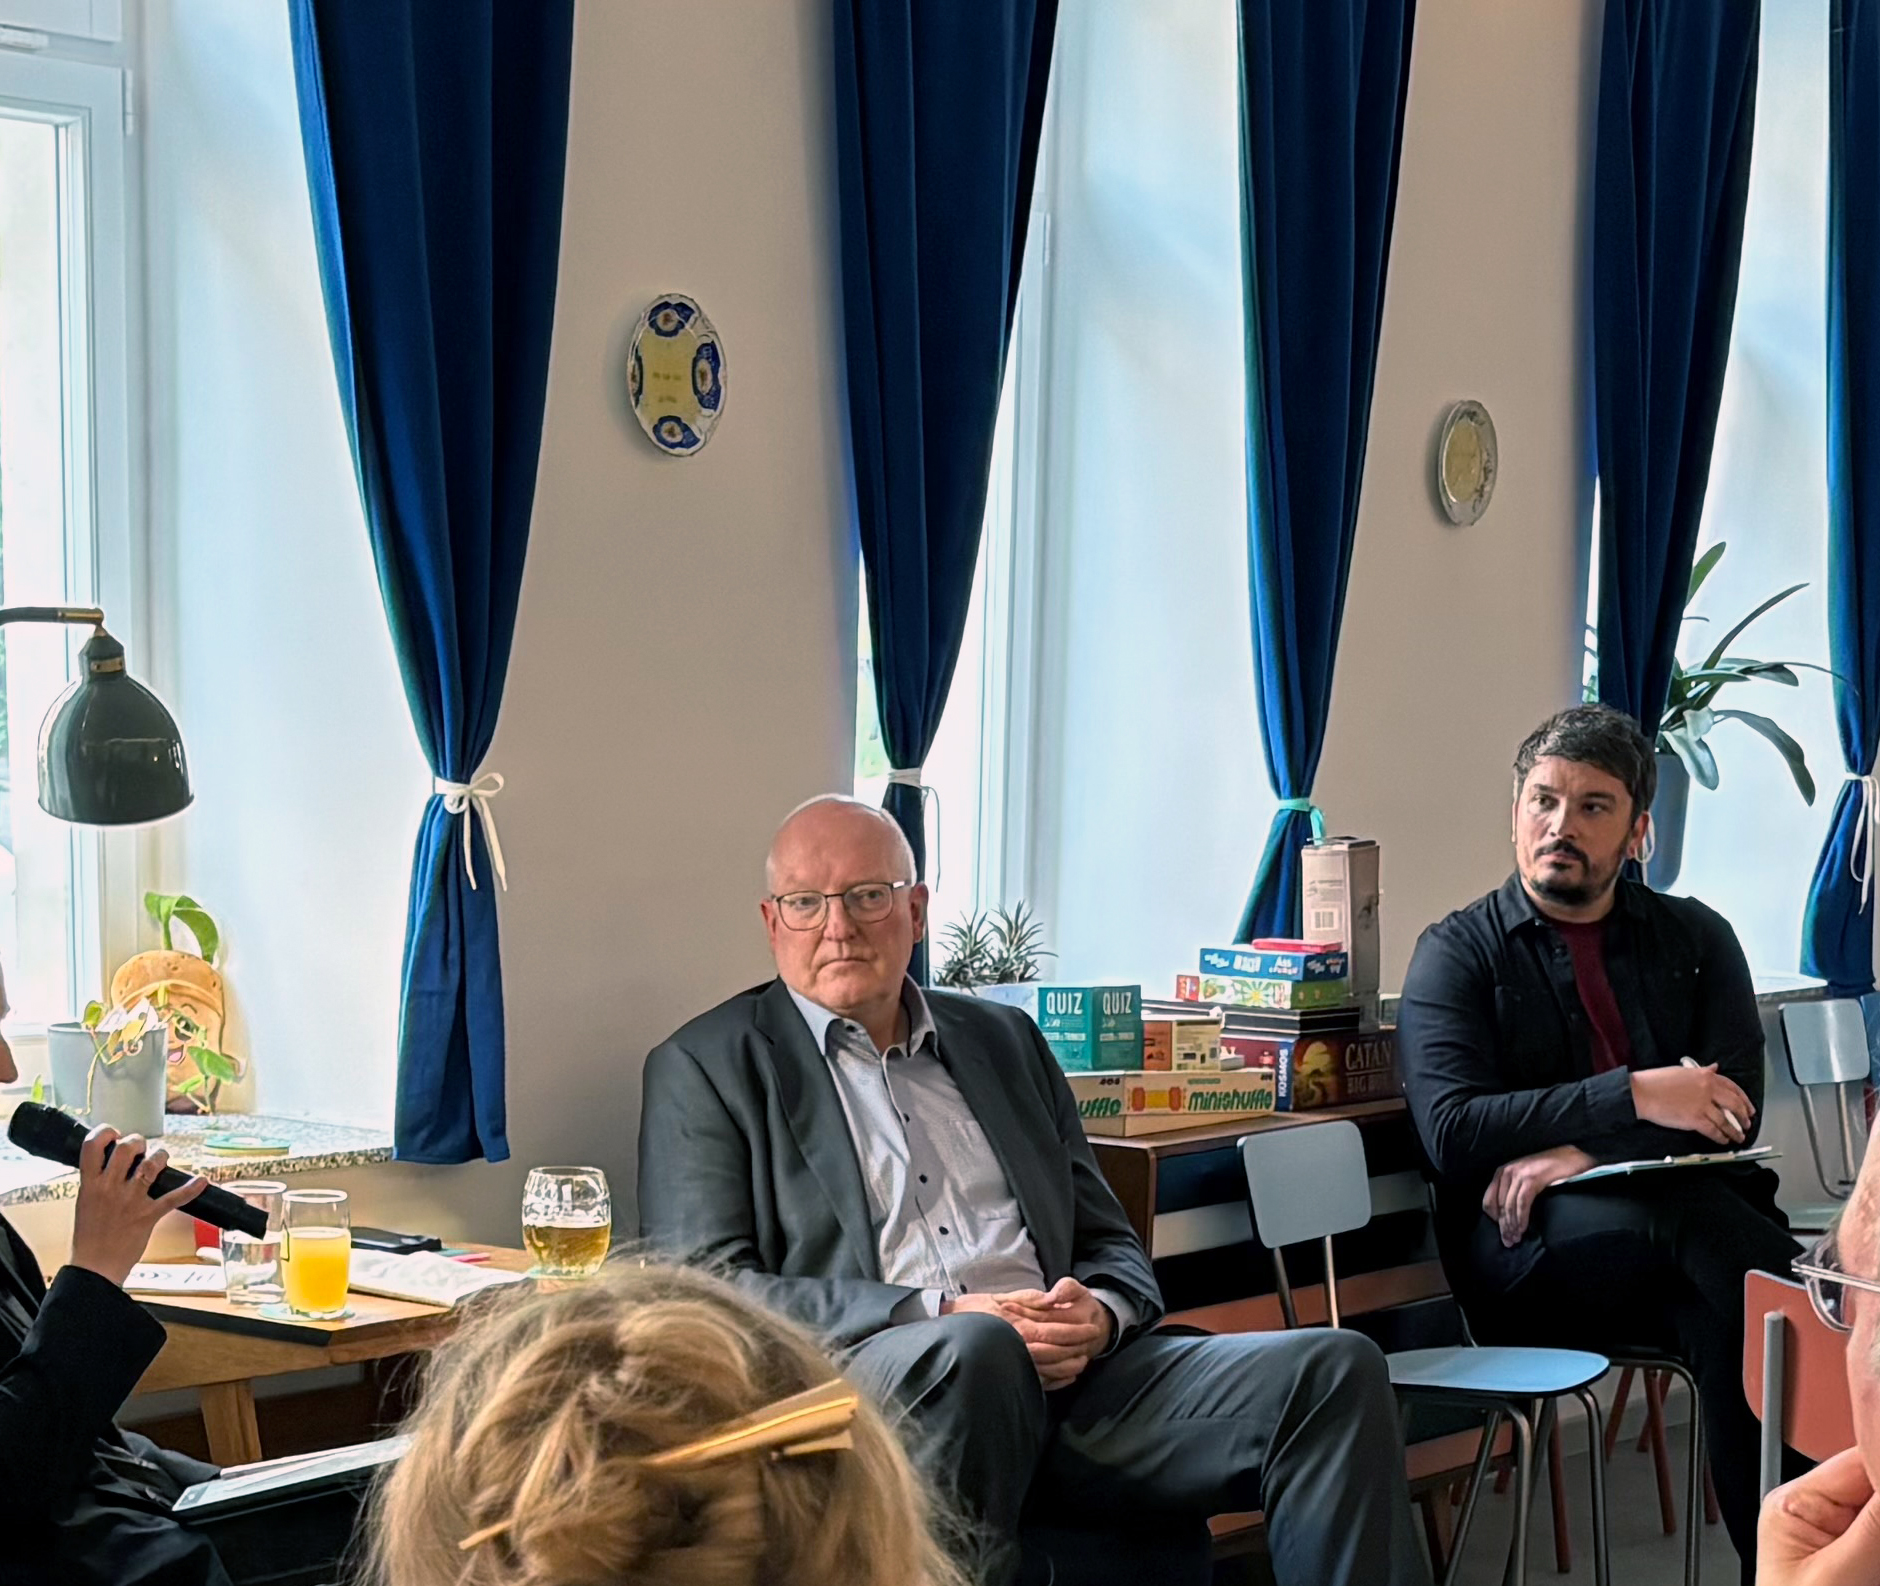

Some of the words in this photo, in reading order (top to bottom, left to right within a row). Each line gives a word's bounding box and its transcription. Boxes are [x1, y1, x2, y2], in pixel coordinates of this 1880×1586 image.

[1046, 992, 1083, 1015] QUIZ
[1102, 992, 1132, 1015] QUIZ
[1345, 1040, 1392, 1070] CATAN
[1278, 1049, 1289, 1097] KOSMOS
